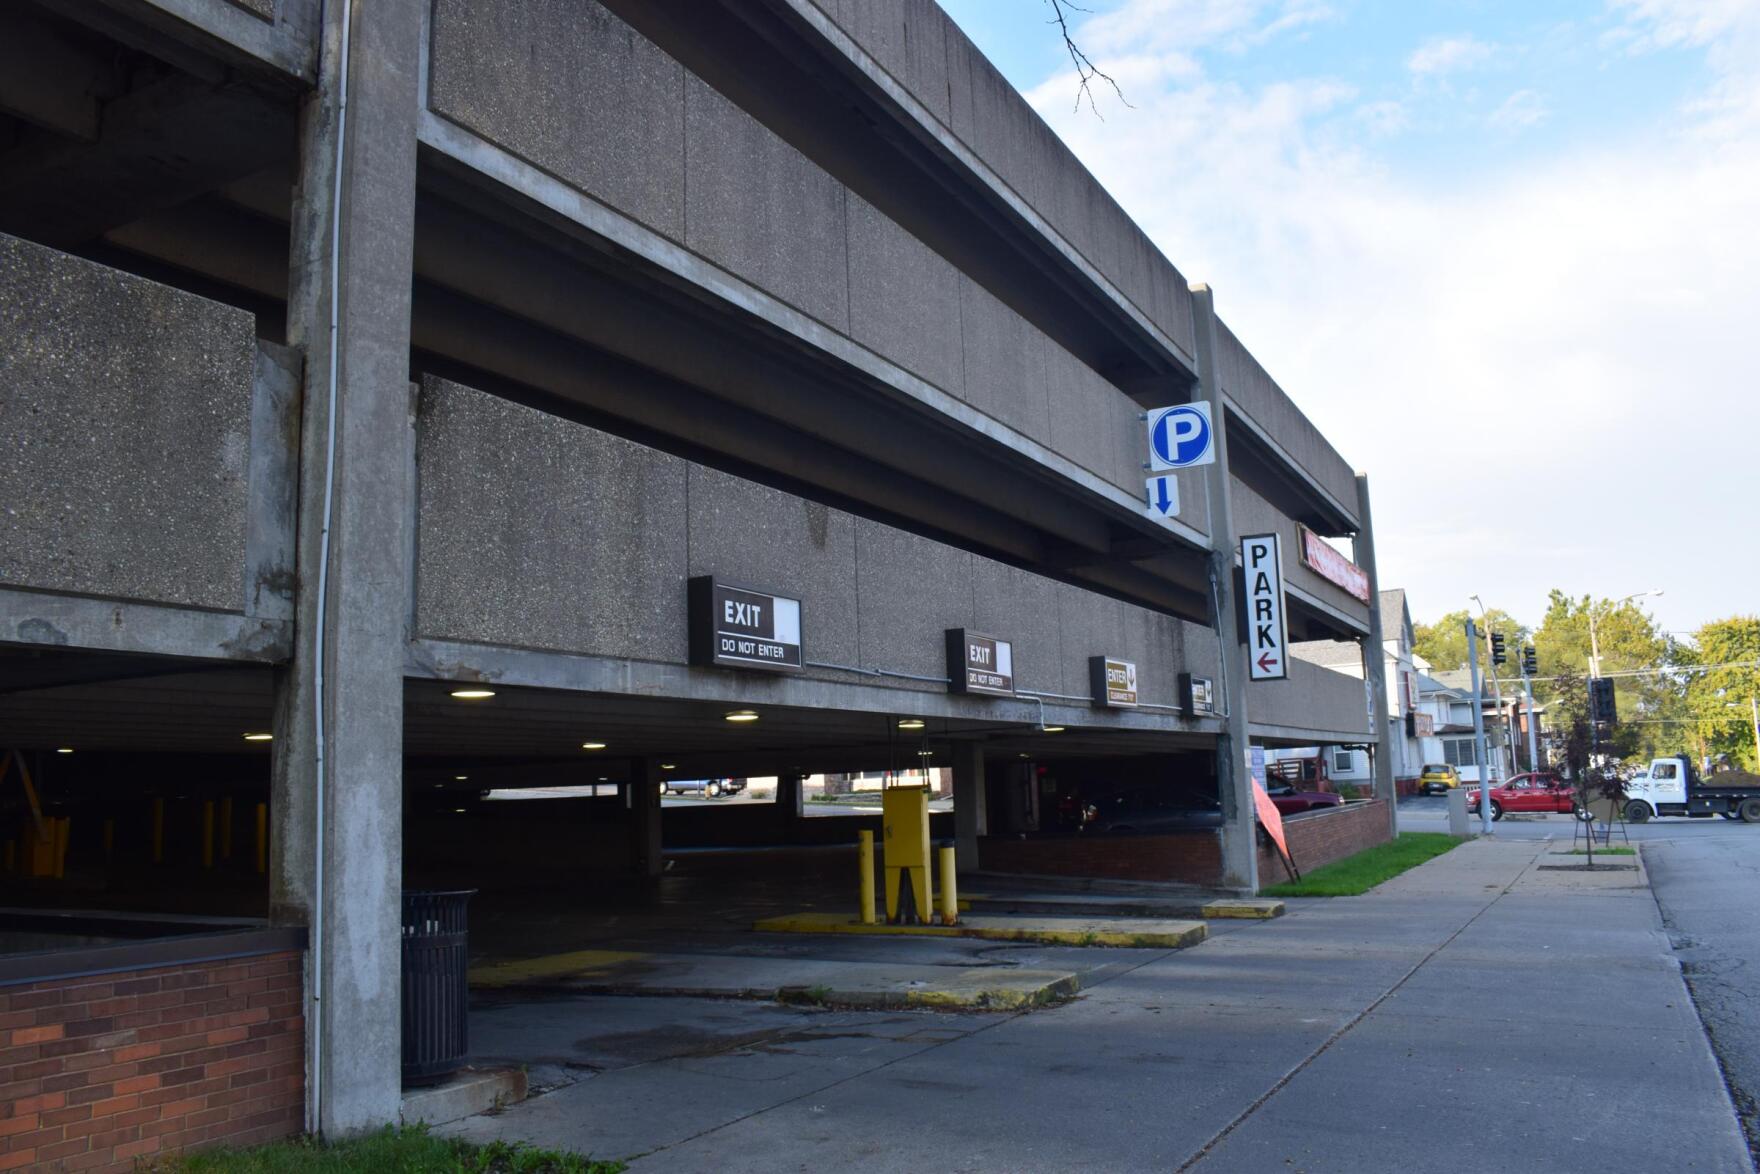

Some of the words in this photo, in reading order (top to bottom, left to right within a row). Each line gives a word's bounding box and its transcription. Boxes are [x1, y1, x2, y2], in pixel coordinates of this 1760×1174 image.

[1165, 412, 1202, 461] P
[1251, 544, 1276, 649] PARK
[724, 600, 761, 628] EXIT
[721, 639, 735, 652] DO
[738, 641, 755, 655] NOT
[758, 643, 784, 658] ENTER
[969, 644, 990, 665] EXIT
[969, 673, 977, 682] DO
[977, 674, 988, 684] NOT
[988, 675, 1003, 686] ENTER
[1107, 668, 1127, 684] ENTER
